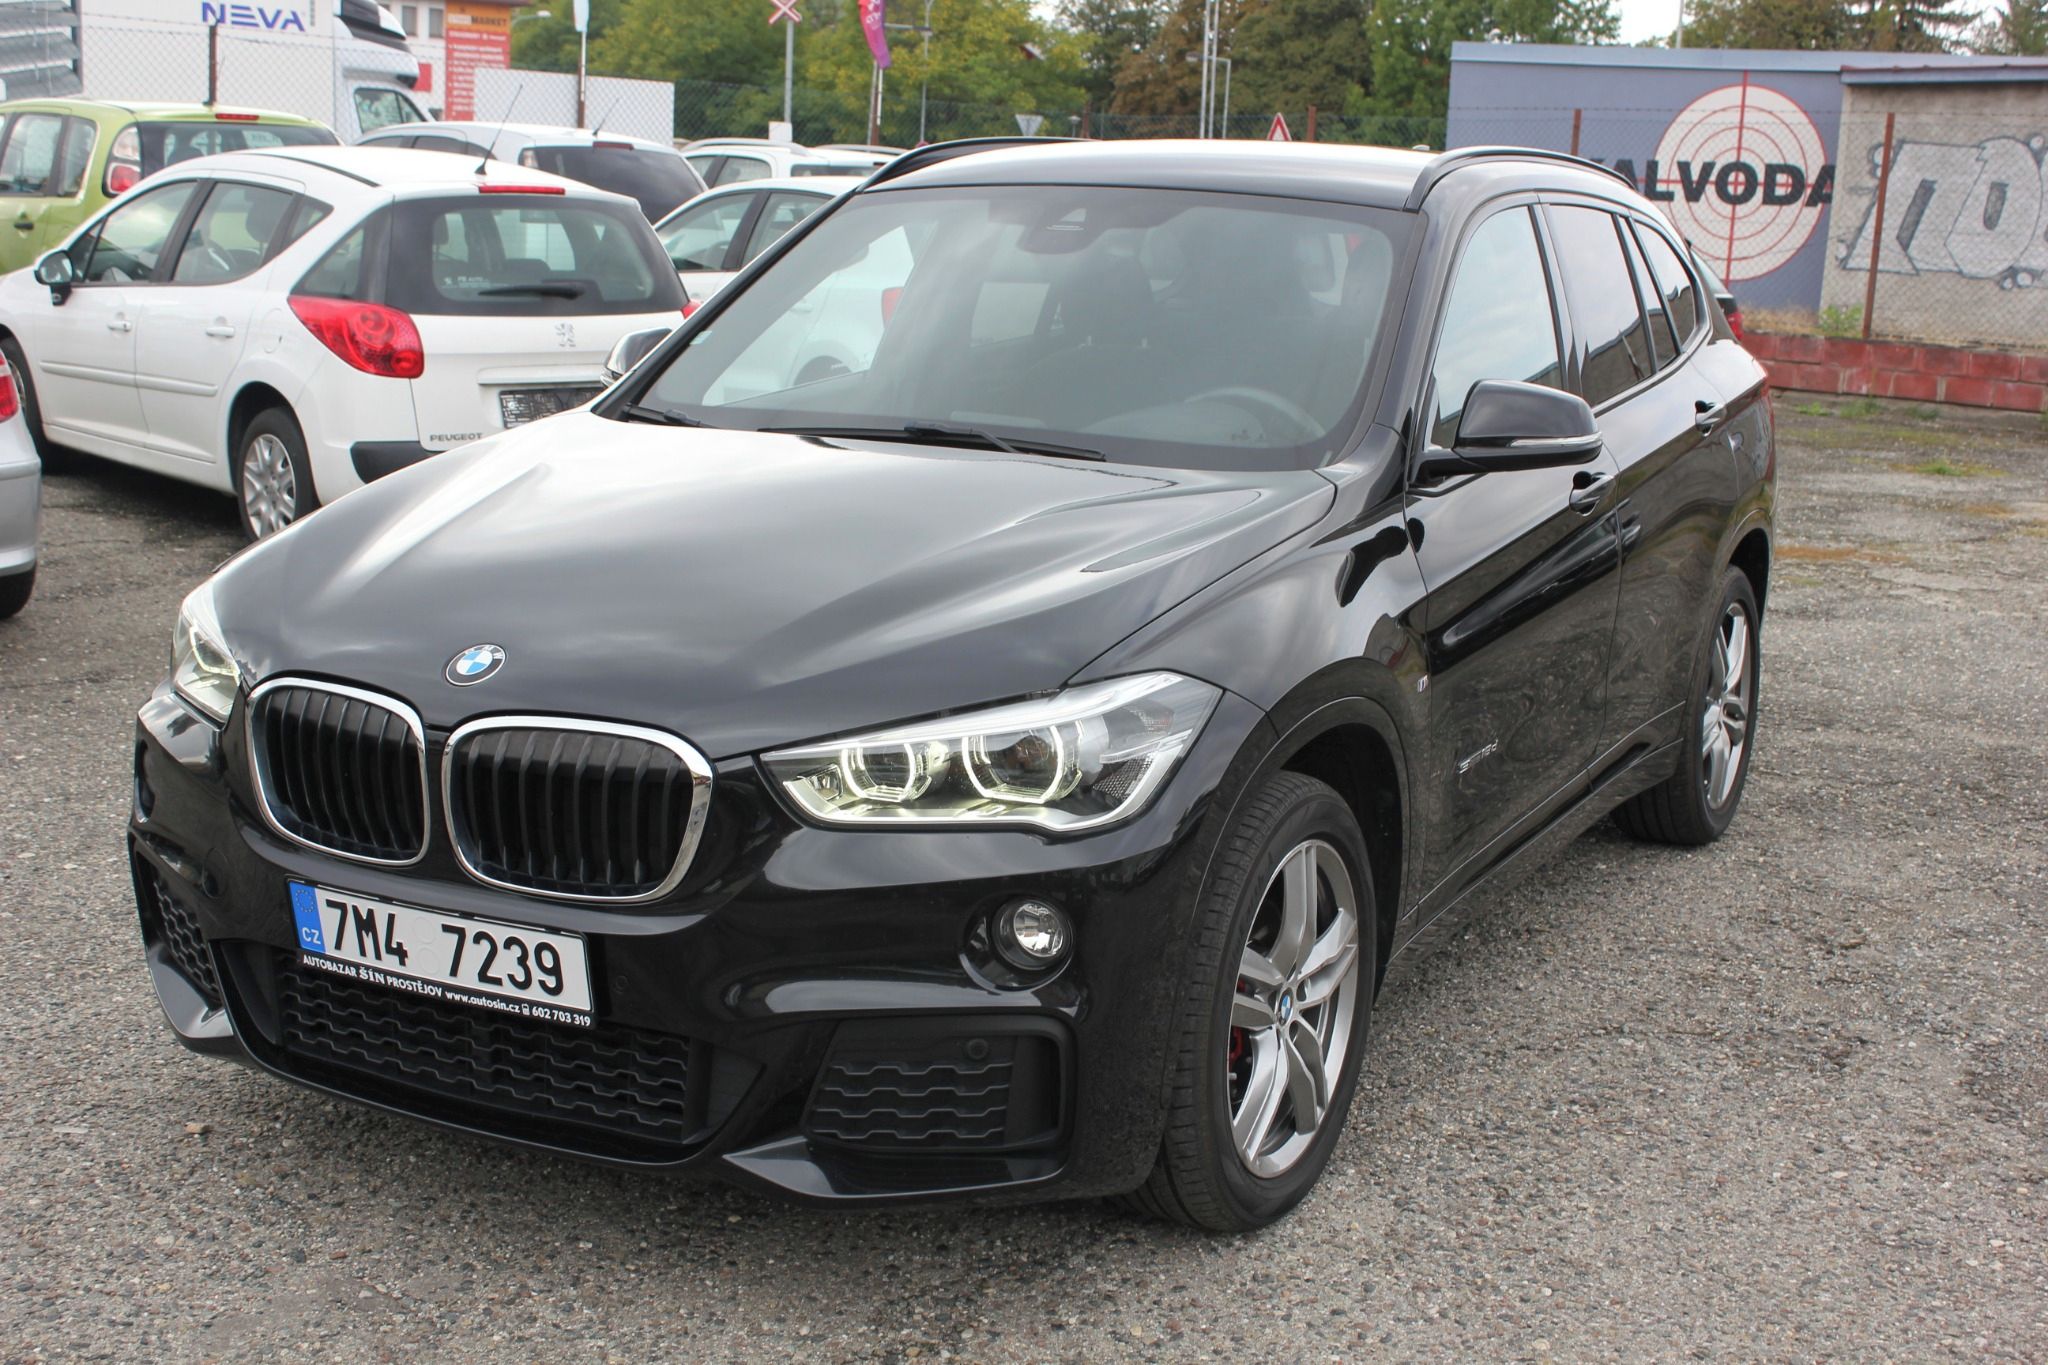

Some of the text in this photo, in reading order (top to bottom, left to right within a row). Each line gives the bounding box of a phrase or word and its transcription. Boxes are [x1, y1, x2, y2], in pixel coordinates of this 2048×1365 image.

[201, 2, 305, 32] NEVA
[1588, 158, 1836, 207] ALVODA
[429, 432, 483, 442] PEUGEOT
[302, 927, 321, 944] CZ
[325, 898, 564, 997] 7M4 7239
[303, 954, 591, 1027] AUTOBAZAR ŠÍN PROSTĚJOV www.autosin.cz 602 703 319
